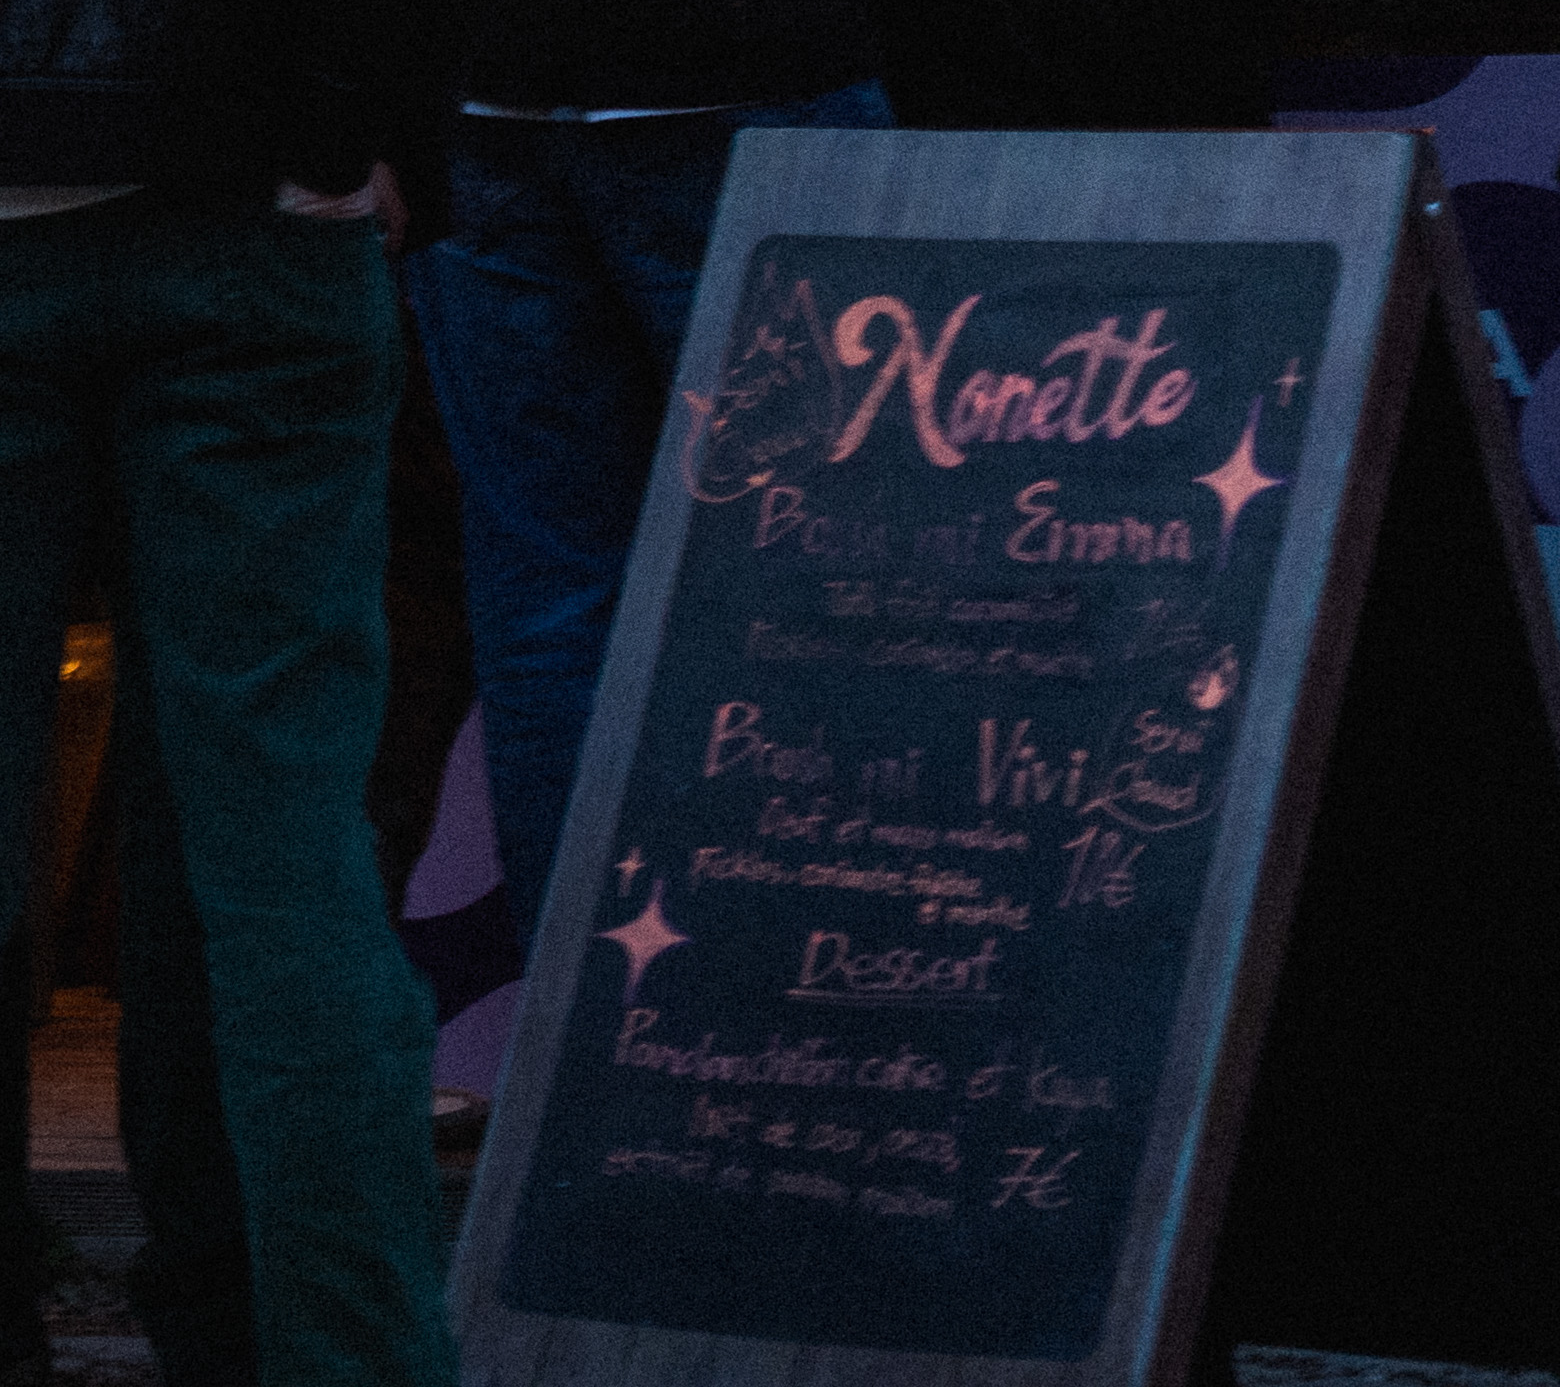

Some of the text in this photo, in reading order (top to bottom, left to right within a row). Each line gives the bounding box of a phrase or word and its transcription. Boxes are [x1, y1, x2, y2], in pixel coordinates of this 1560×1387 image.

[827, 293, 1197, 468] Nonette
[1004, 478, 1194, 564] Emma
[978, 717, 1089, 807] Vivi
[796, 929, 1002, 993] Dessert
